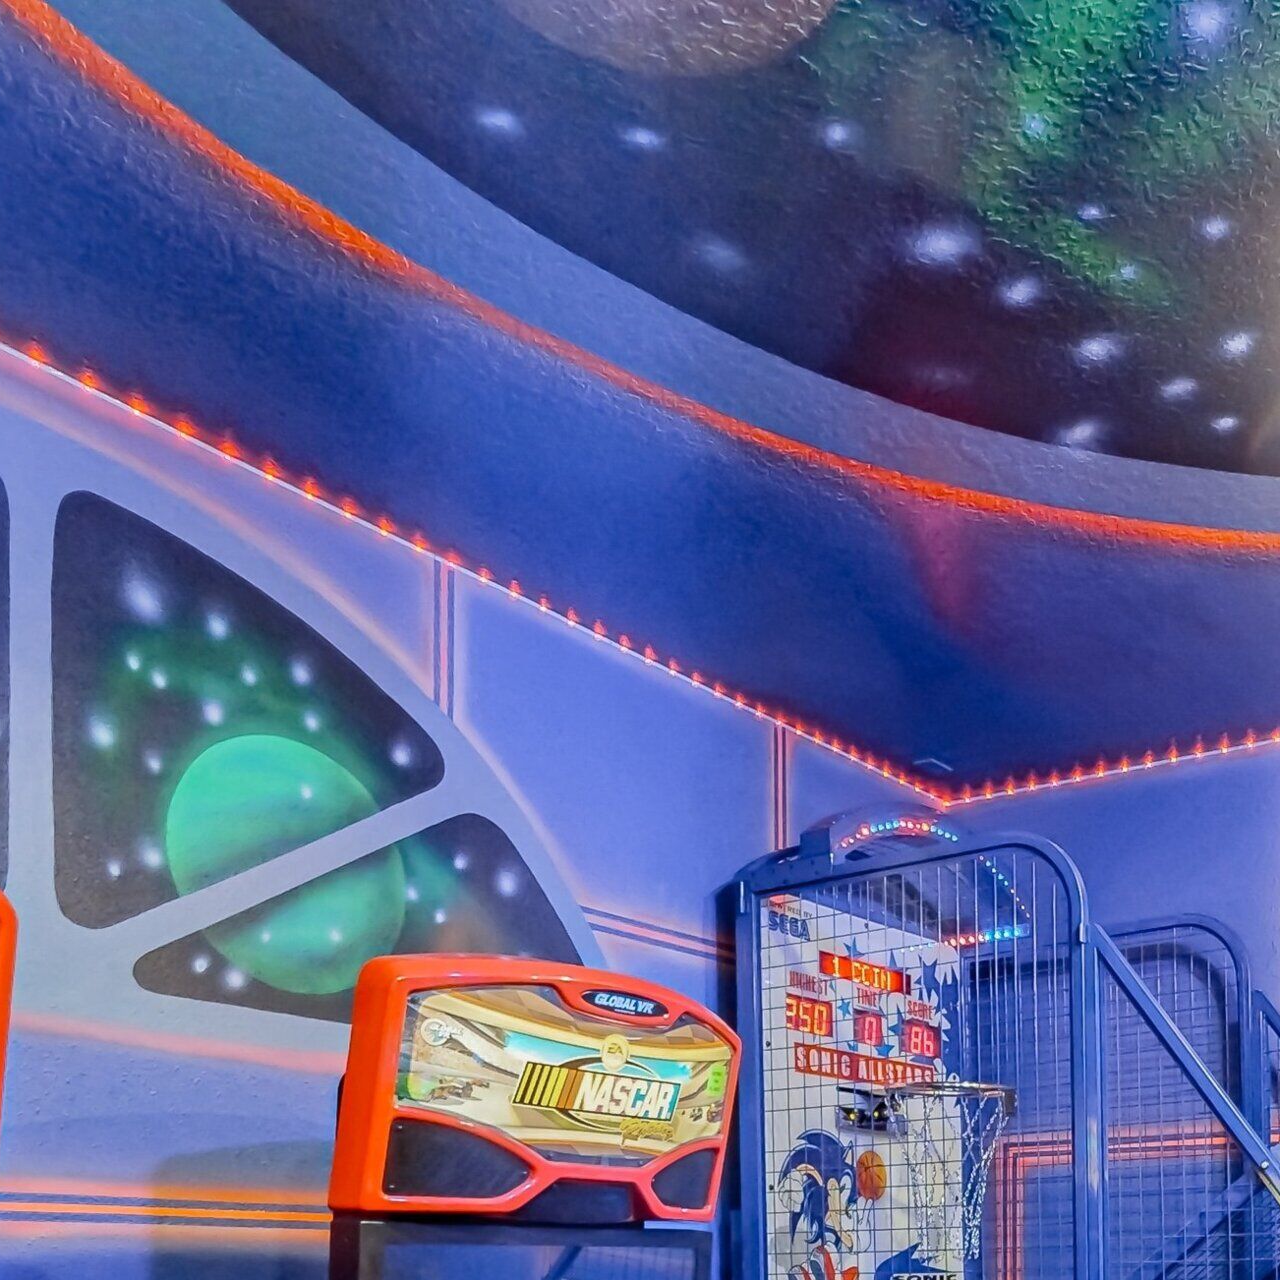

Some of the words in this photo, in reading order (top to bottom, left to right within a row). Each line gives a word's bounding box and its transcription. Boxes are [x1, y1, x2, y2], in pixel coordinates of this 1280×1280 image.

[769, 910, 811, 941] SEGA
[832, 956, 840, 978] 1
[852, 961, 892, 991] COIN
[594, 992, 636, 1011] GLOBAL
[636, 1000, 655, 1014] VR
[906, 999, 934, 1021] SCORE
[796, 1046, 852, 1081] SONIC
[857, 1059, 934, 1085] ALLSTARS
[573, 1072, 675, 1120] NASCAR
